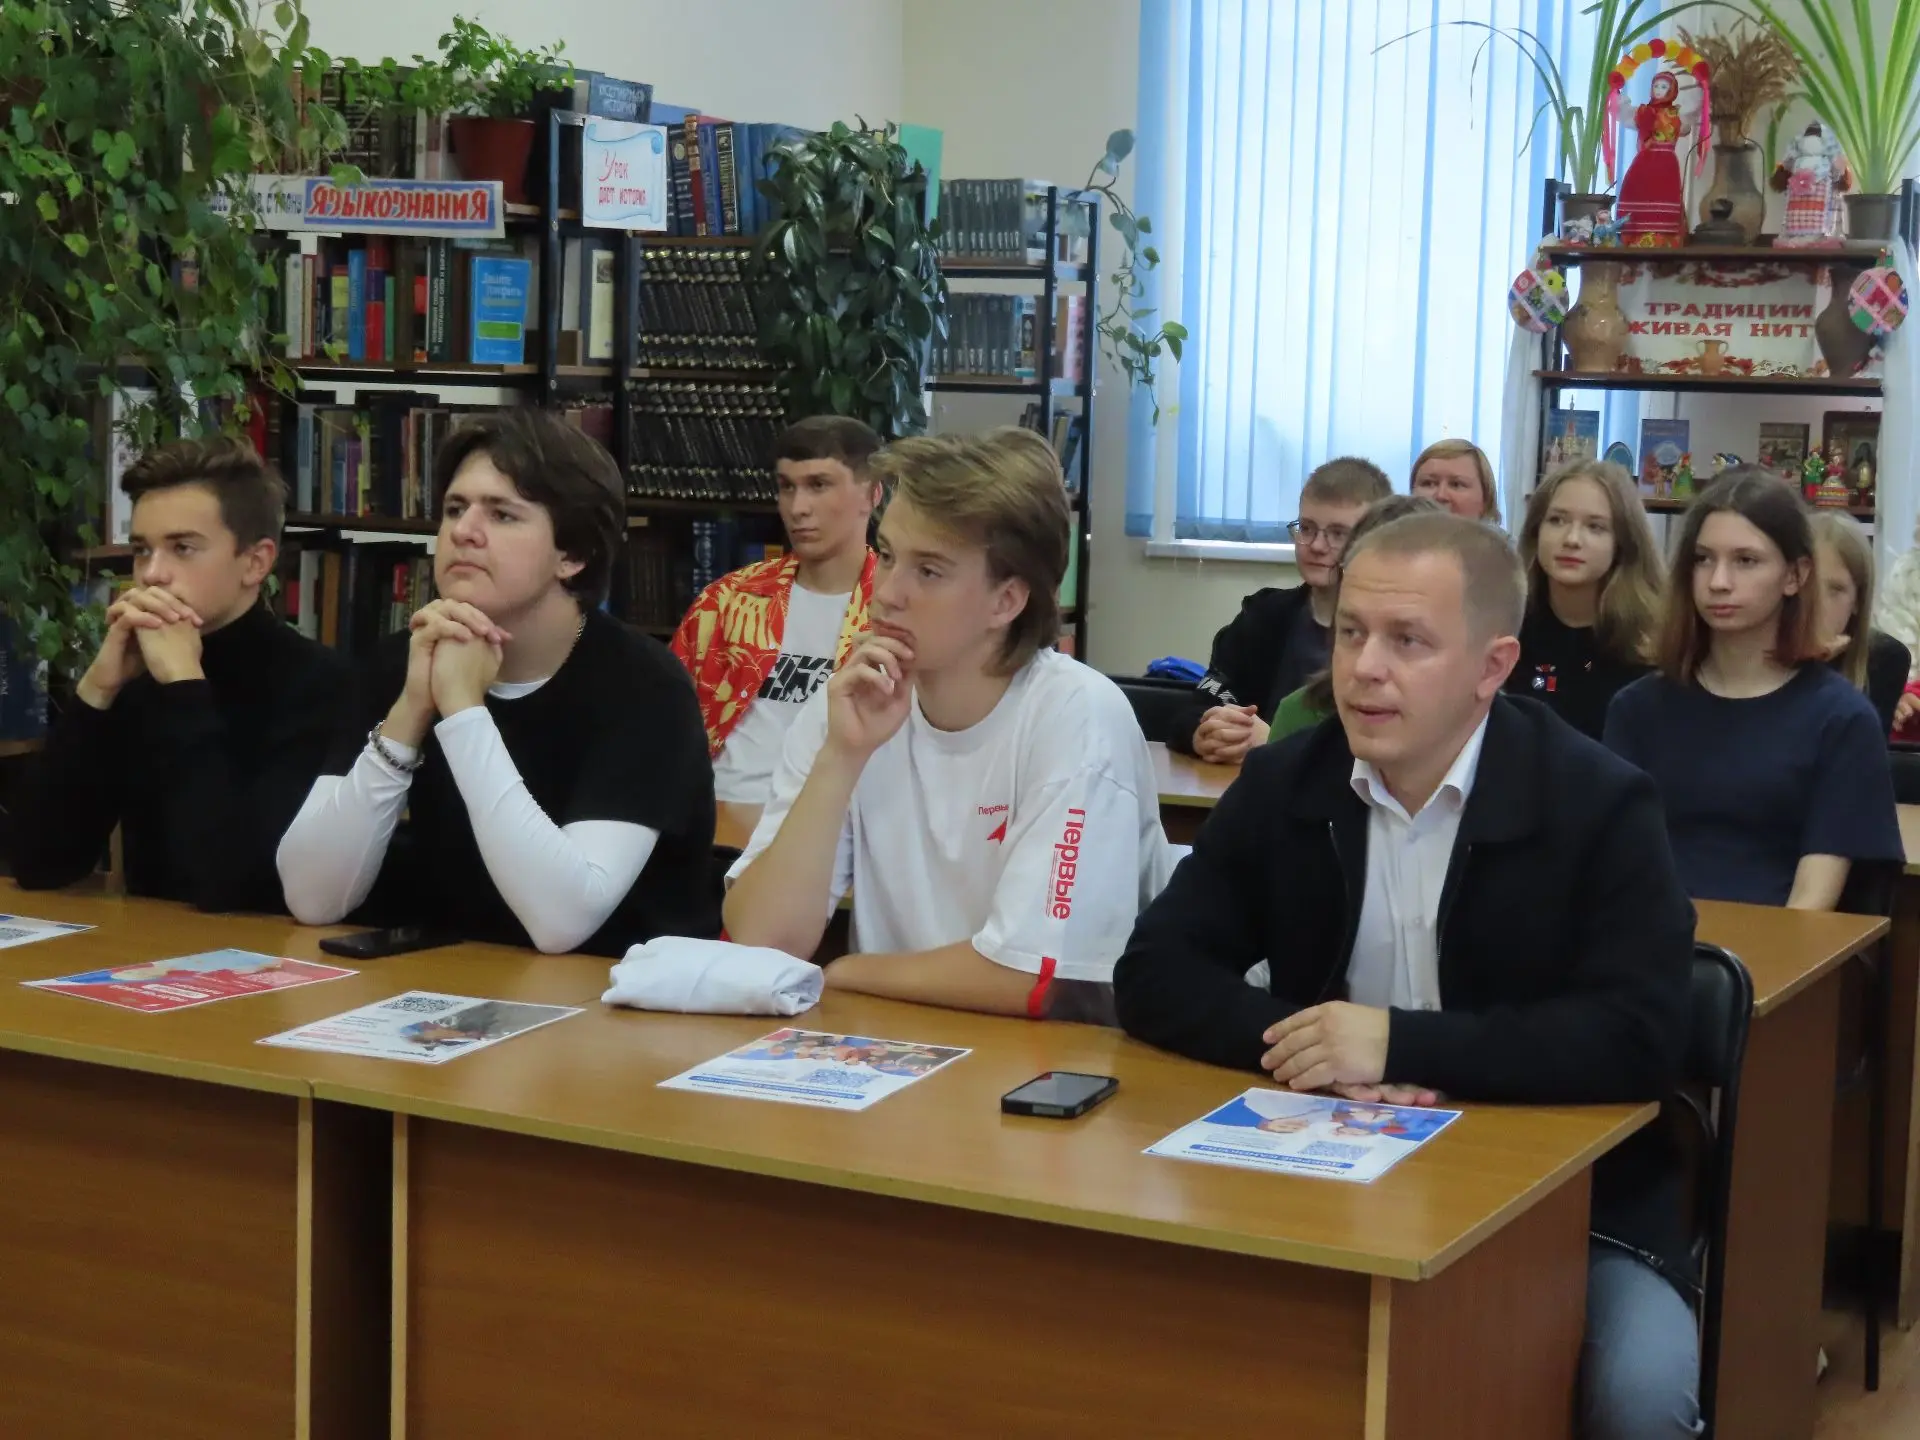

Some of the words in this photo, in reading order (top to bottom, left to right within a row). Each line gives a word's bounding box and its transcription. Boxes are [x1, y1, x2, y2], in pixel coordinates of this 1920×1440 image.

[1644, 302, 1814, 320] ТРАДИЦИИ
[1627, 321, 1732, 337] ЖИВАЯ
[1749, 323, 1814, 338] НИТ
[1053, 808, 1086, 920] Первые
